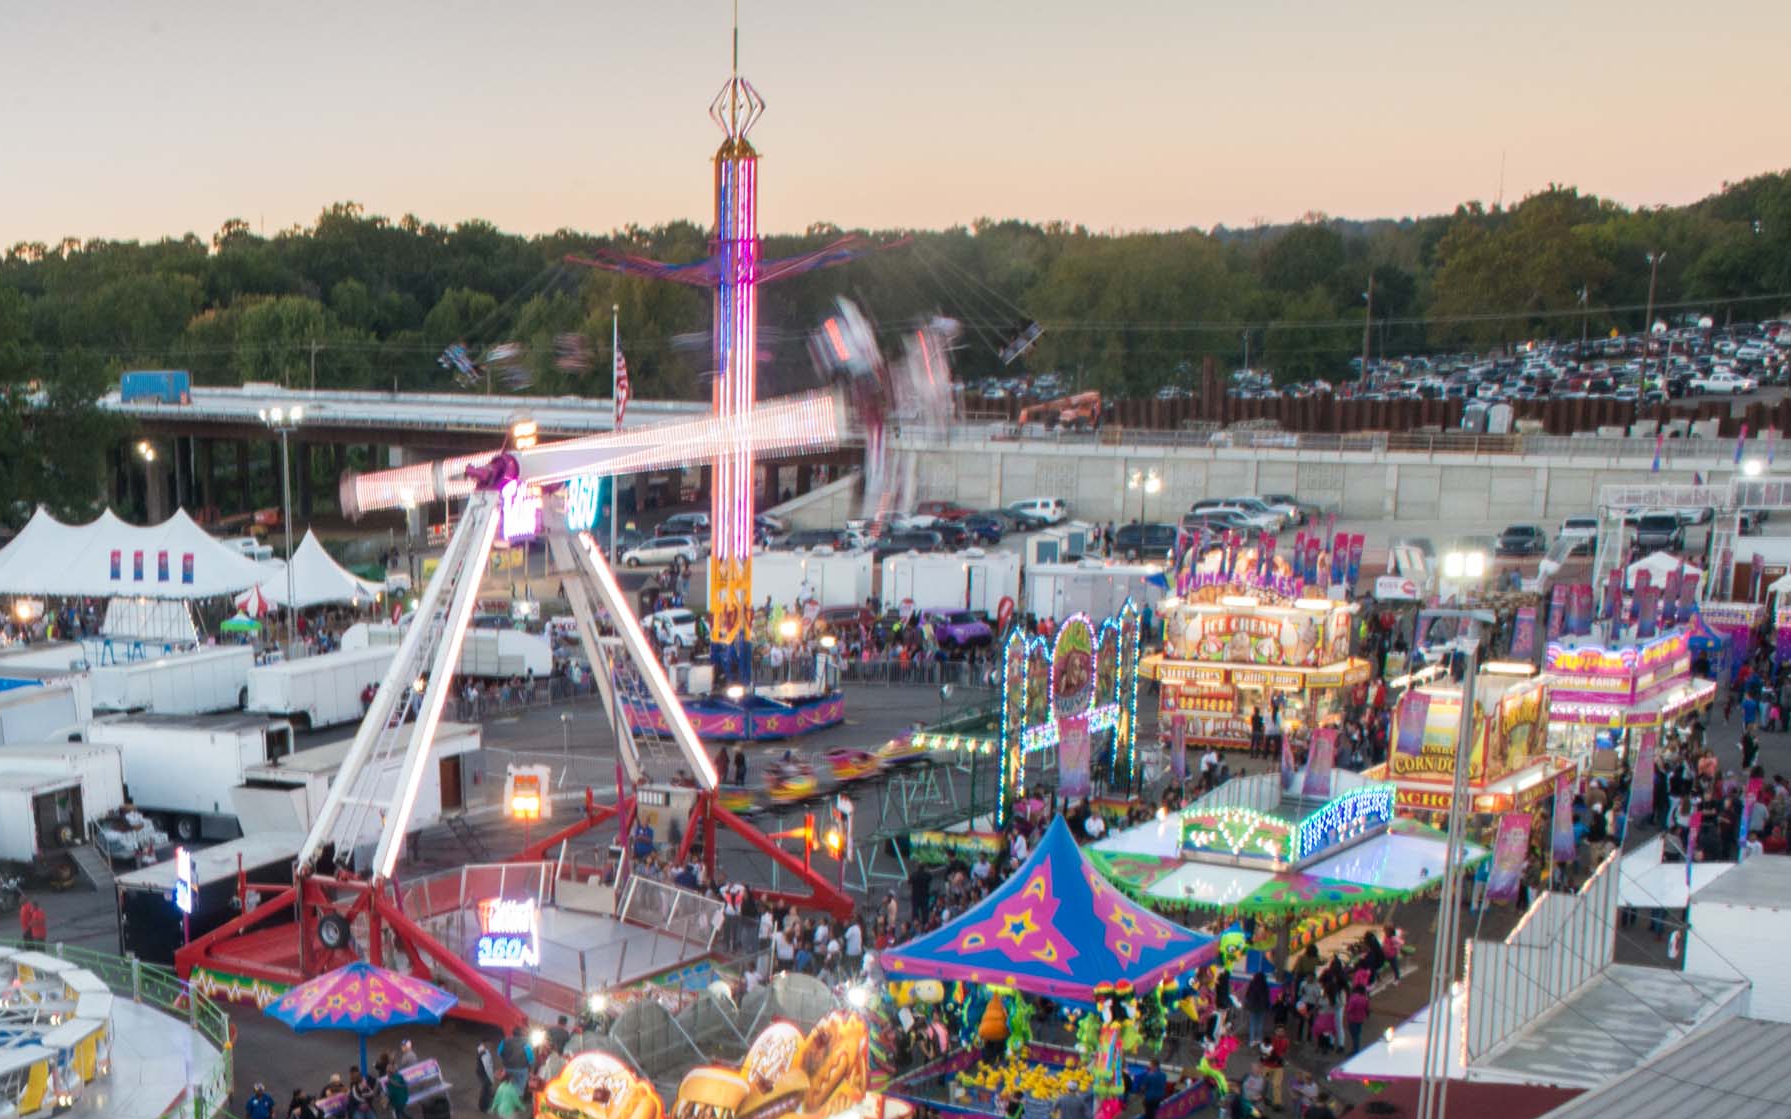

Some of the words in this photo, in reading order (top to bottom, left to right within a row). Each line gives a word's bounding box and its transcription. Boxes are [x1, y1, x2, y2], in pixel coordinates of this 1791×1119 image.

[1204, 618, 1226, 634] ICE
[1230, 616, 1279, 637] CREAM
[1394, 793, 1453, 807] ACHO
